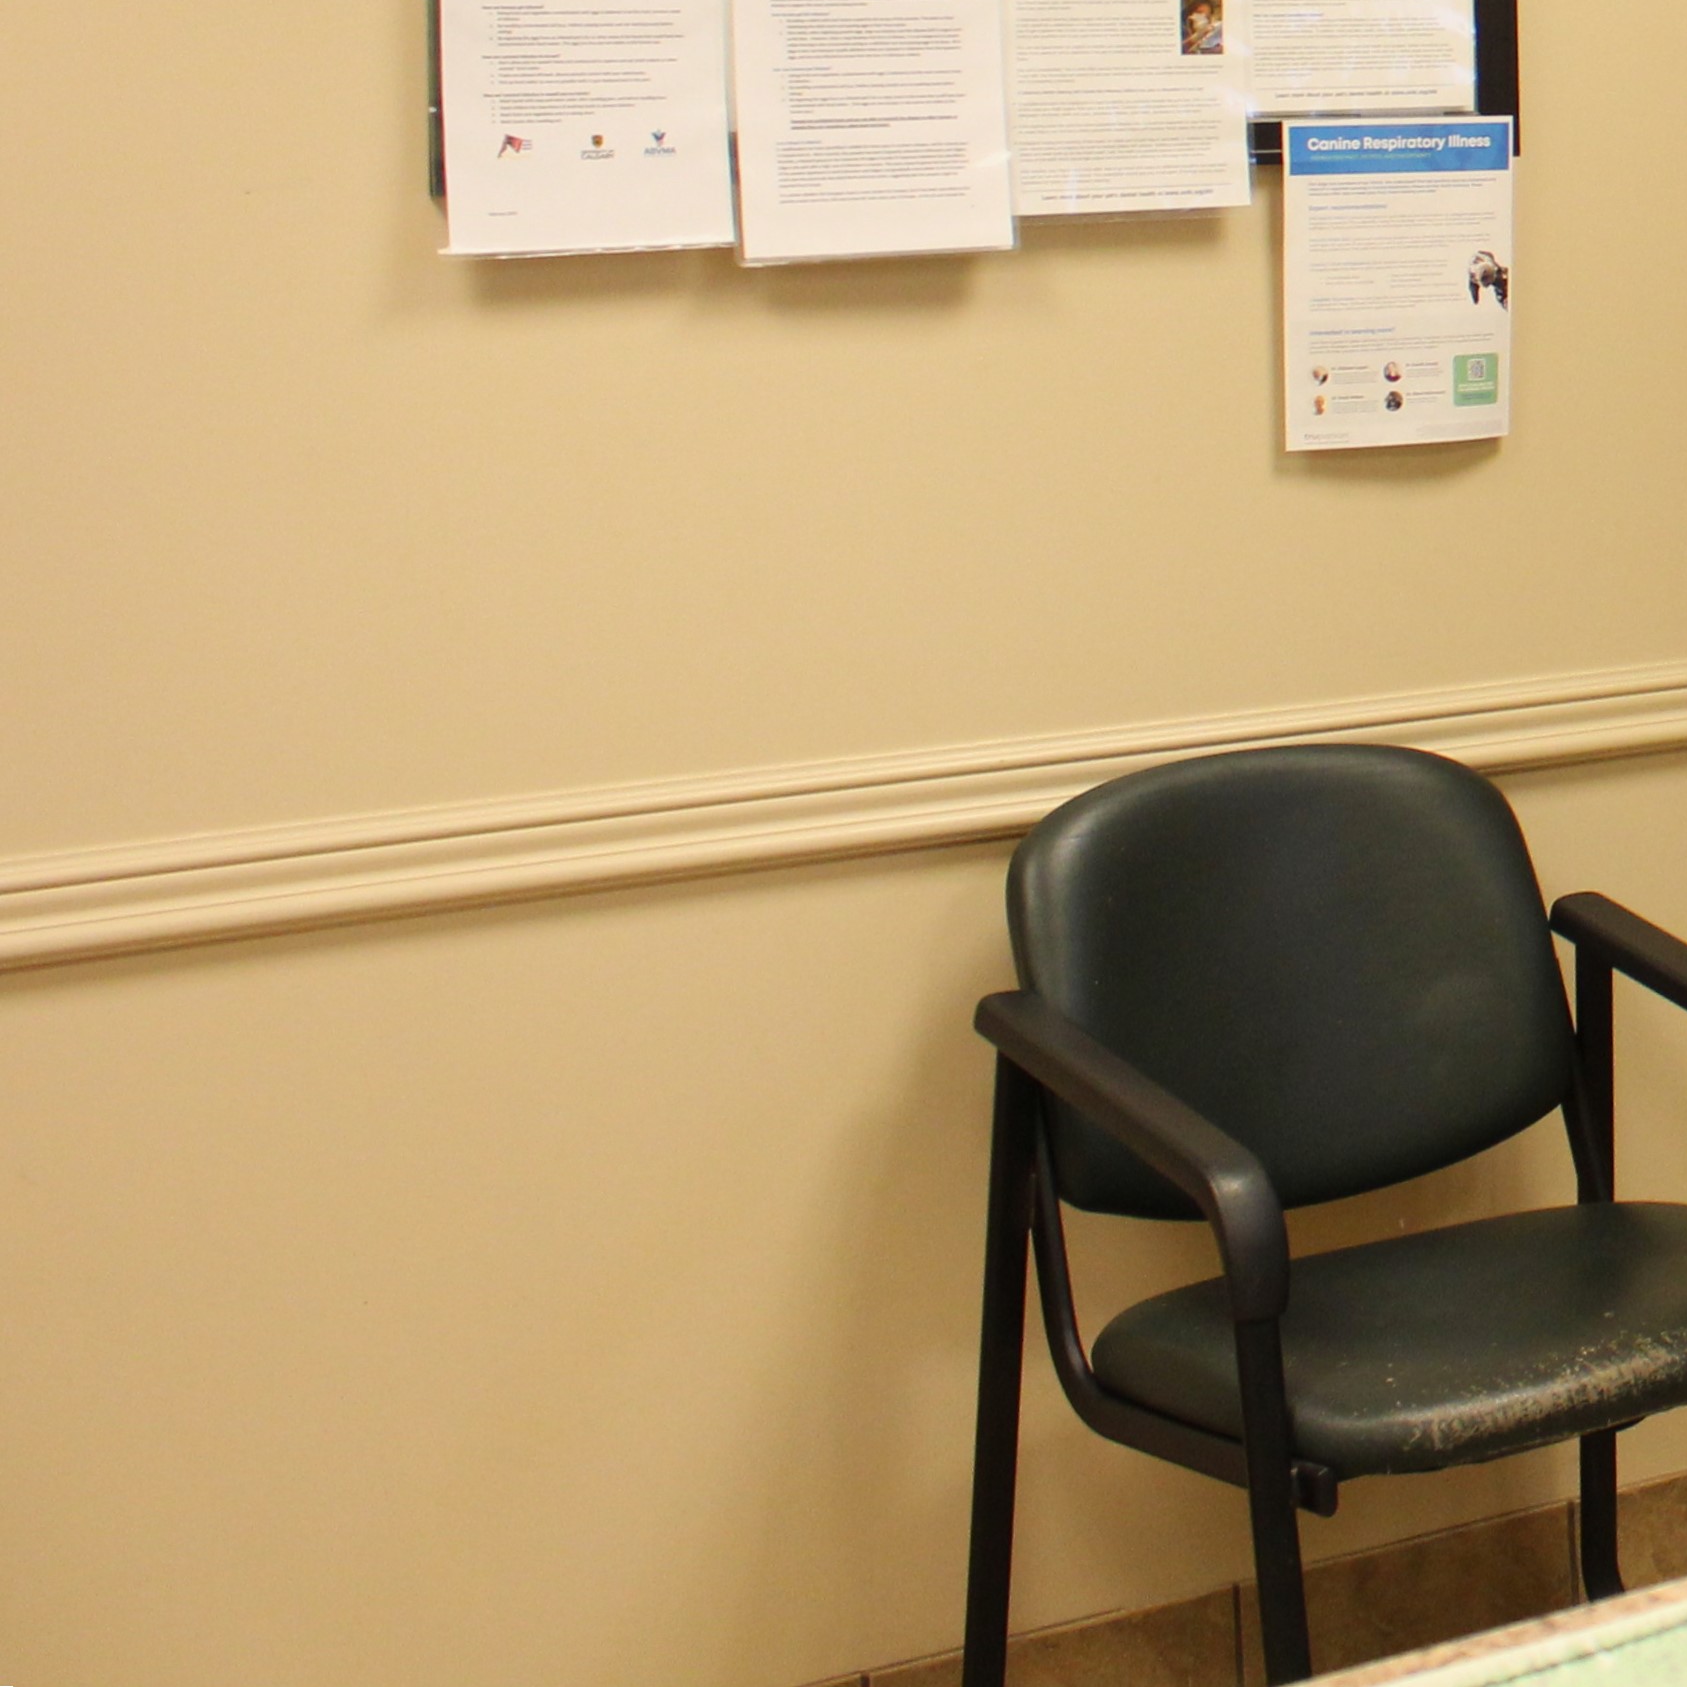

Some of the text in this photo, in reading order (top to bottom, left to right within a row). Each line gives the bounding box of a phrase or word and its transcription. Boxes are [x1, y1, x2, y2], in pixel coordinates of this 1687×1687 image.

[1307, 134, 1492, 153] Canine Respiratory Illness
